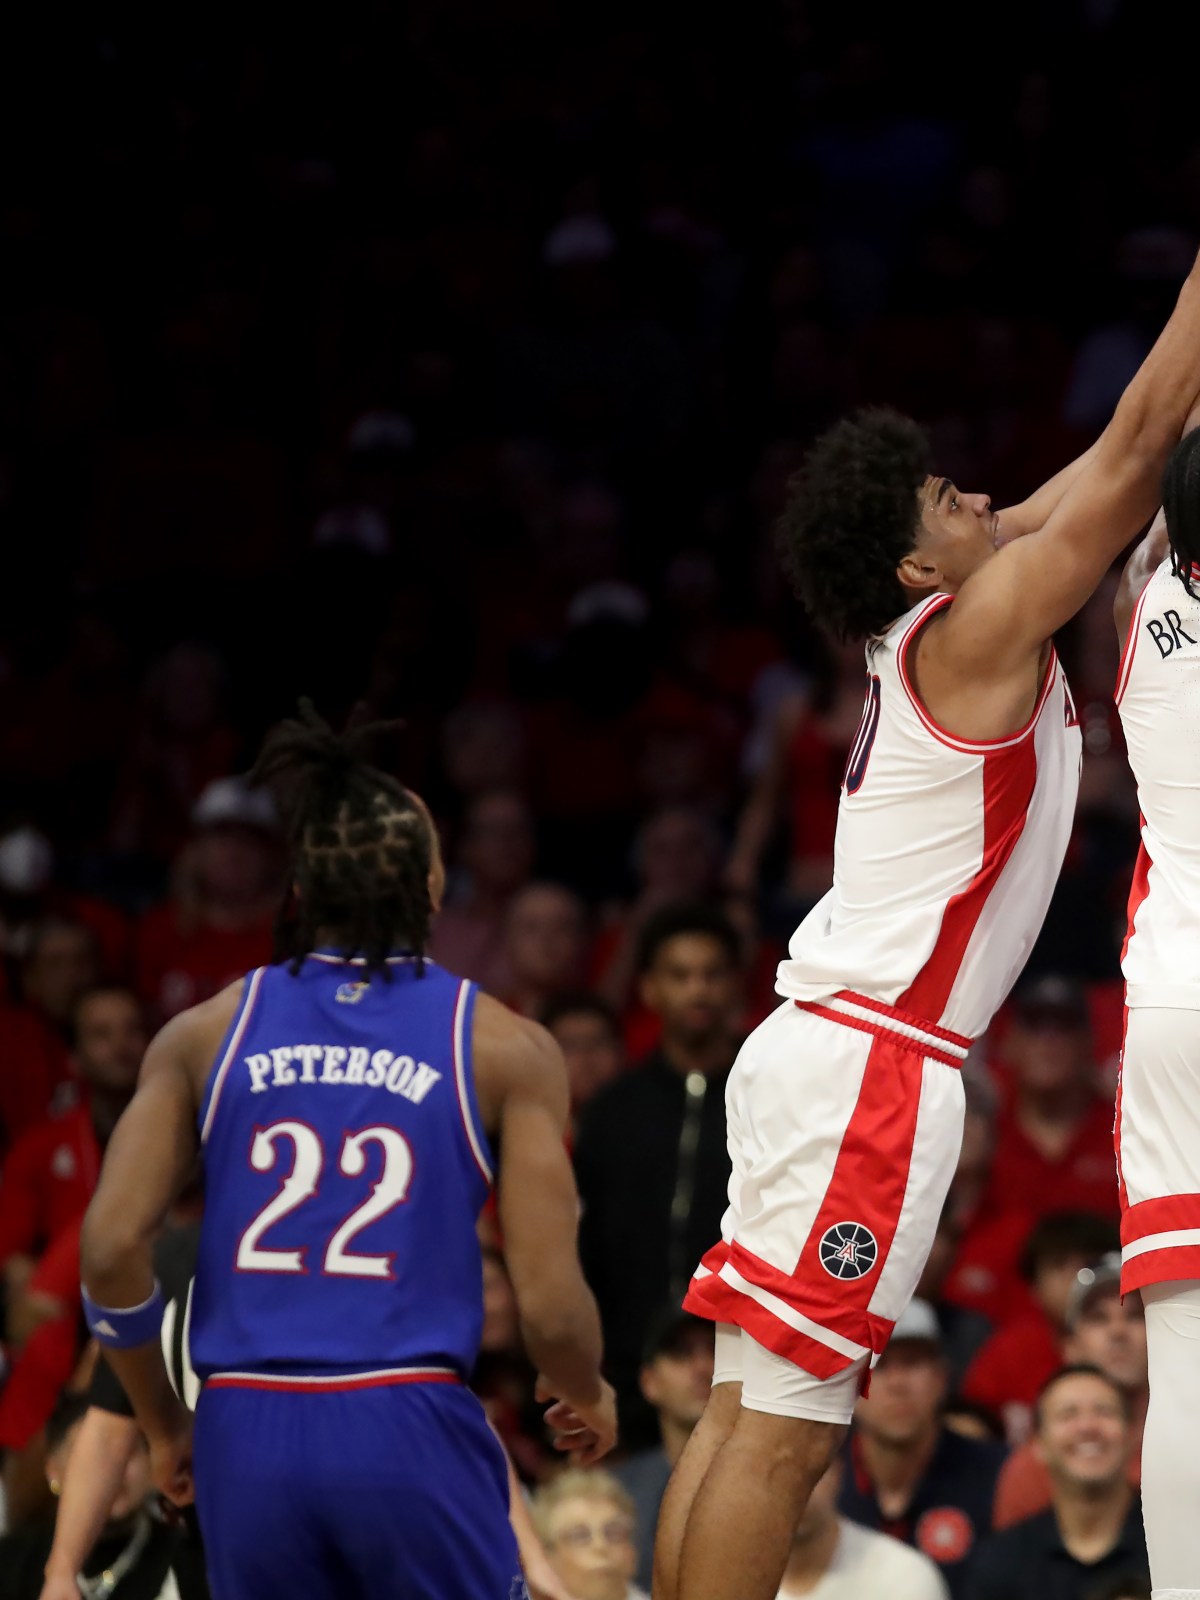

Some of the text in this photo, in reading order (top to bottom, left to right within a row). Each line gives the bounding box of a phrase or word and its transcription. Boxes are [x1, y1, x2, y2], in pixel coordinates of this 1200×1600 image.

[244, 1044, 442, 1105] PETERSON
[233, 1118, 414, 1281] 22
[834, 1238, 859, 1265] A
